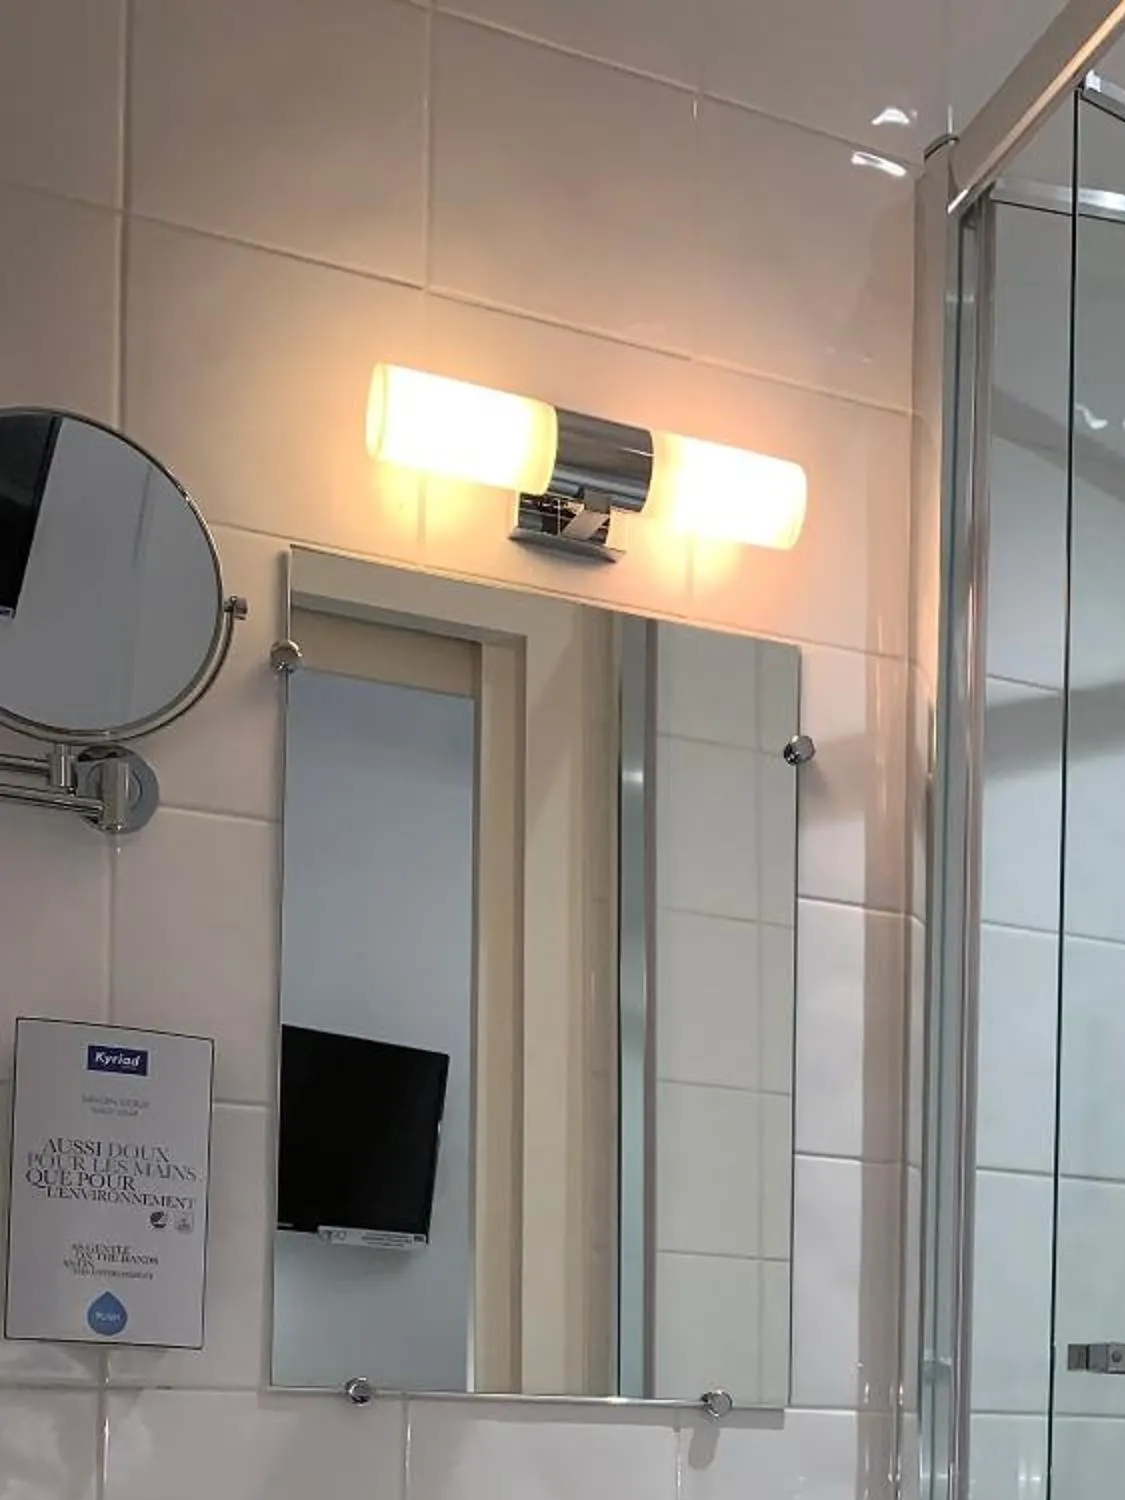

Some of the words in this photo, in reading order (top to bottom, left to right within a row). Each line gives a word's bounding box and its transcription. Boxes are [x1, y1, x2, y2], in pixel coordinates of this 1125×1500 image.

[95, 1051, 141, 1067] Kyriad
[42, 1137, 102, 1157] AUSSI
[108, 1142, 171, 1163] DOUX
[28, 1151, 86, 1172] POUR
[93, 1157, 129, 1175] LES
[133, 1161, 197, 1182] MAINS
[25, 1168, 73, 1189] QUE
[77, 1172, 136, 1191] POUR
[46, 1186, 197, 1209] L'ENVIRONNEMENT
